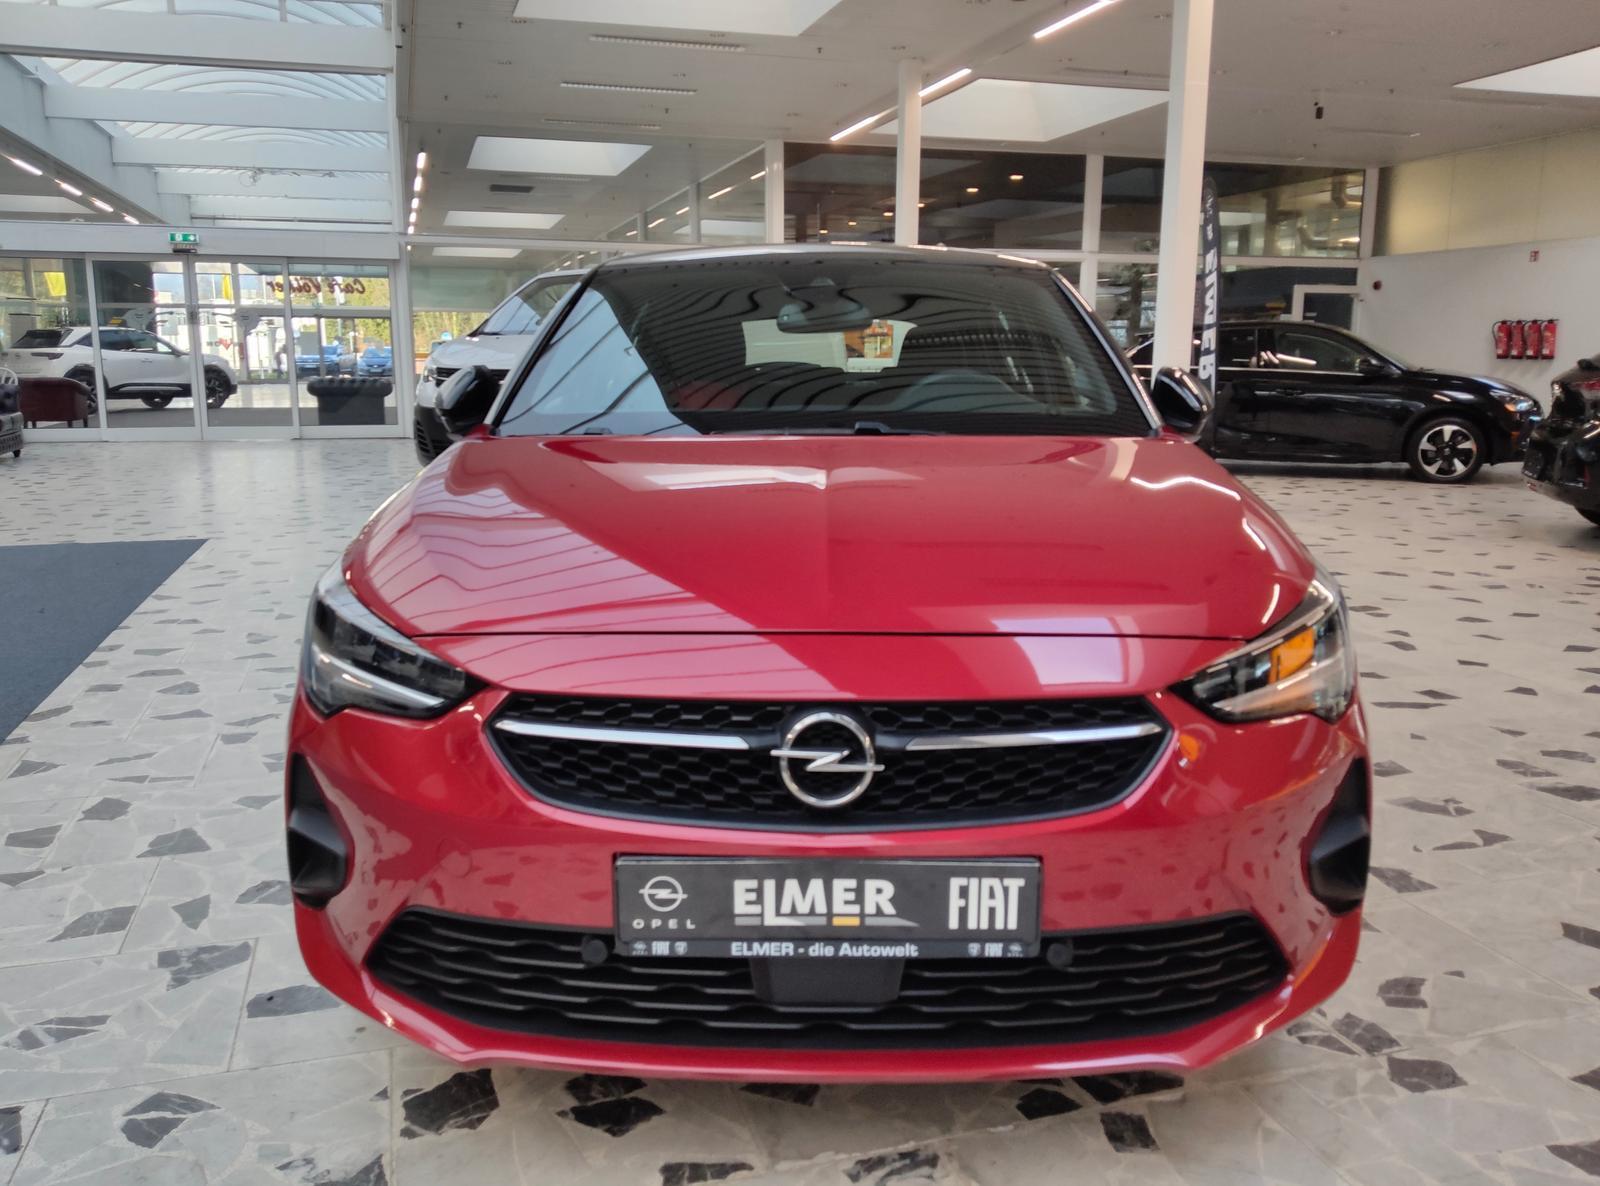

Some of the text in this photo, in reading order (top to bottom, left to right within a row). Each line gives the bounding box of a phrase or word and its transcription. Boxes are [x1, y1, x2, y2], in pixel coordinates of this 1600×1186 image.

[733, 878, 897, 927] ELMER
[948, 876, 1026, 930] FIAT
[632, 918, 696, 930] OPEL
[730, 941, 795, 956] ELMER
[808, 941, 834, 957] die
[838, 942, 919, 957] Autowelt
